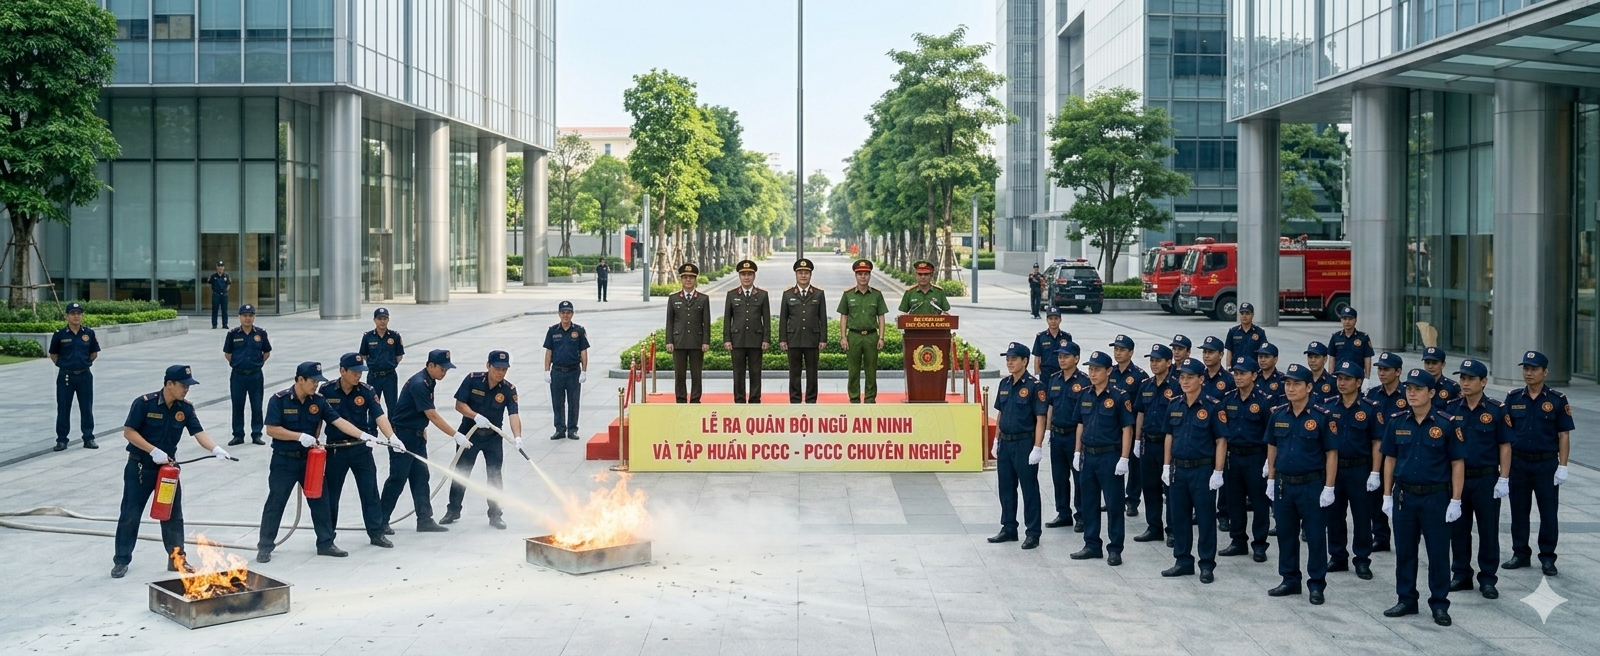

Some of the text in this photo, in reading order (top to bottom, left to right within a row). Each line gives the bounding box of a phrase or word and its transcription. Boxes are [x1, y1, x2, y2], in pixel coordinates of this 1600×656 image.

[702, 411, 718, 434] LỄ
[722, 417, 742, 434] RA
[745, 414, 785, 436] QUÂN
[818, 414, 848, 434] NGŨ
[851, 417, 872, 434] AN
[876, 417, 913, 434] NINH
[652, 439, 672, 460] VÀ
[675, 439, 703, 464] TẬP
[707, 438, 747, 460] HUẤN
[751, 443, 790, 460] PCCC
[804, 443, 843, 460] PCCC
[847, 440, 904, 460] CHUYÊN
[908, 440, 962, 465] NGHIỆP
